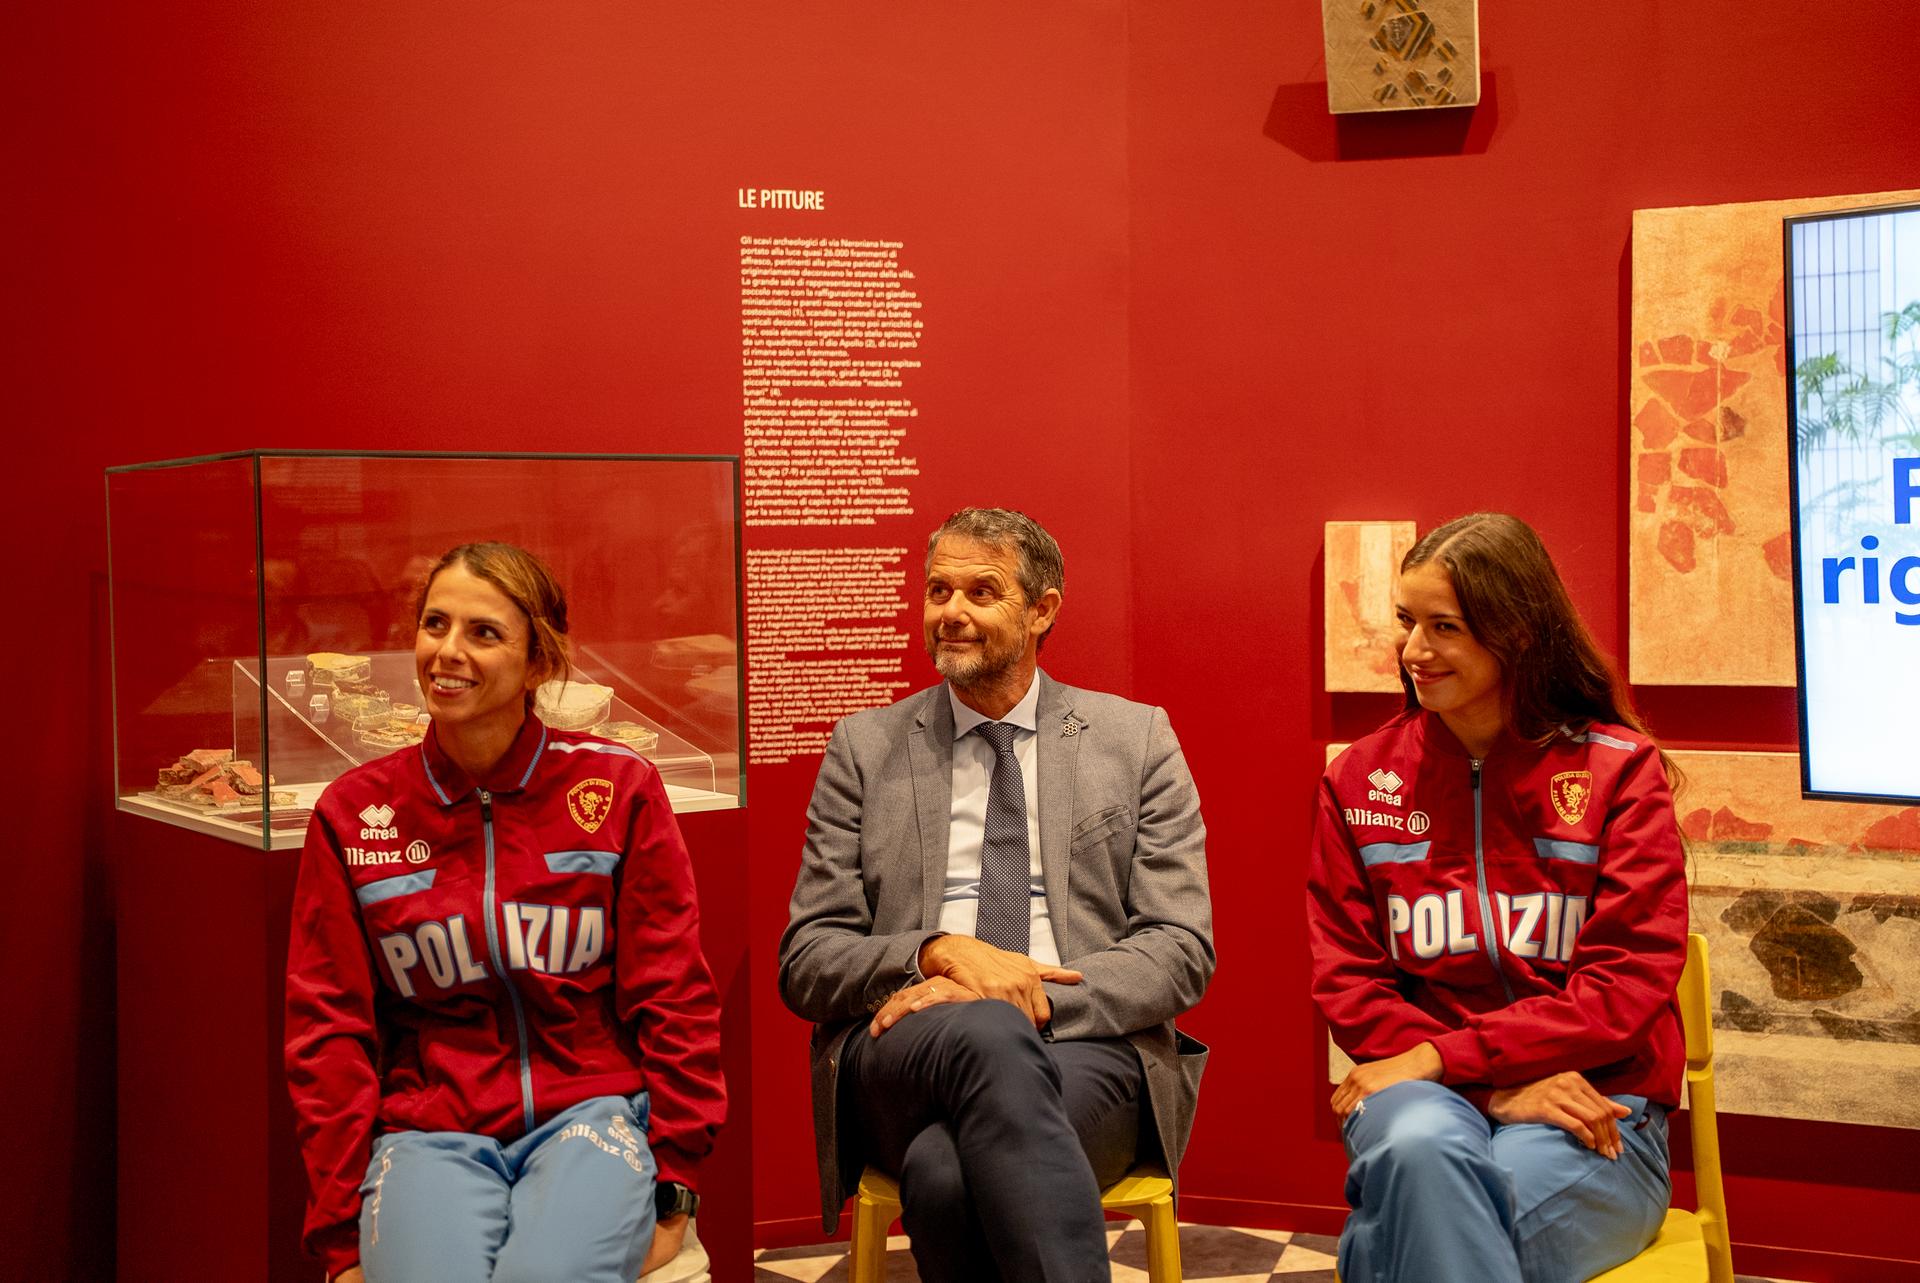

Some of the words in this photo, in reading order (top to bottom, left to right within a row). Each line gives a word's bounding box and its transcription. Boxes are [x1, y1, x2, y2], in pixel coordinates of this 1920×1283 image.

[738, 188, 757, 208] LE
[760, 189, 825, 210] PITTURE
[1822, 535, 1920, 626] rig
[1344, 808, 1404, 831] Allianz
[344, 847, 402, 865] llianz
